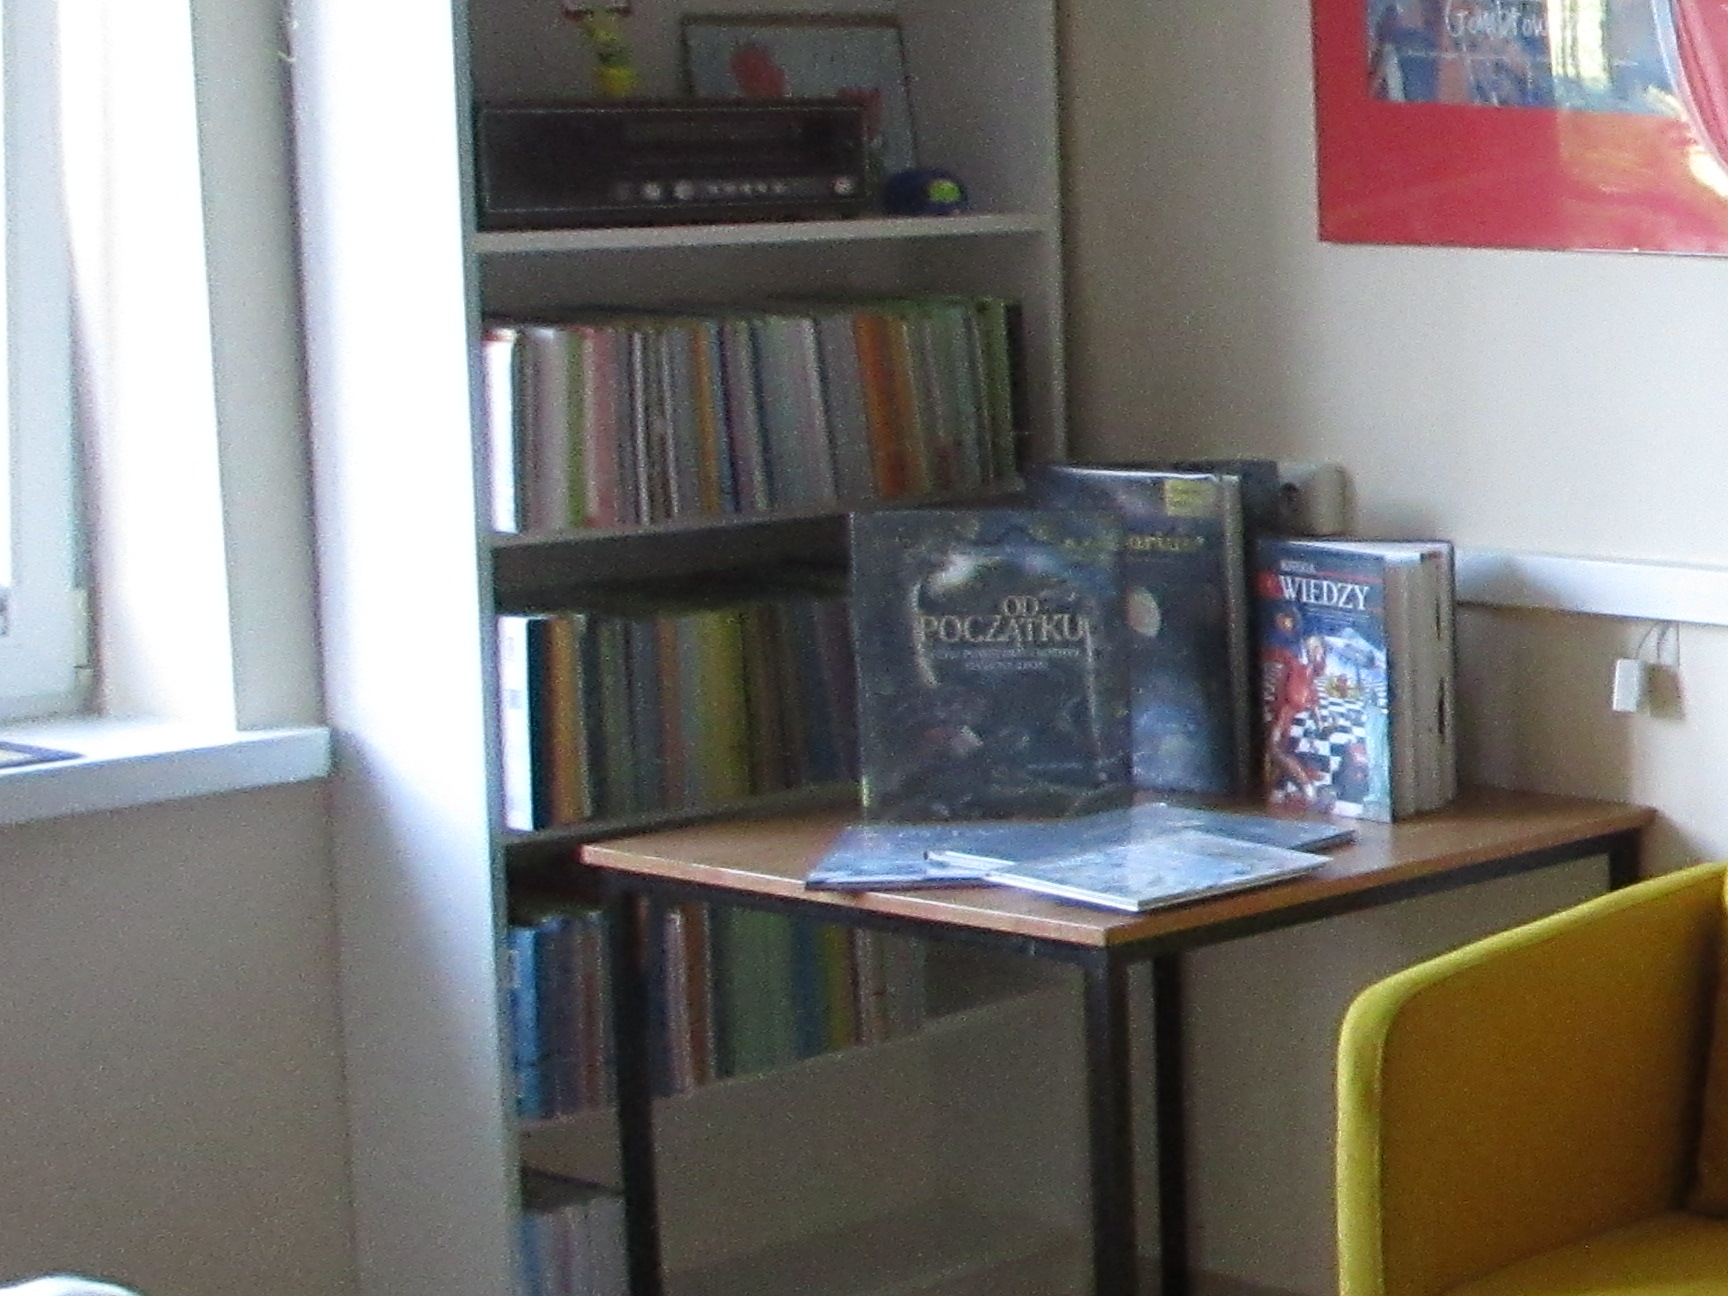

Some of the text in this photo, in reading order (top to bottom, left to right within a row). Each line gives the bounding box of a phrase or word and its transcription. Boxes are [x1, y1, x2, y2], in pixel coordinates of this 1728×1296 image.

[1003, 595, 1039, 617] OD
[1279, 574, 1371, 611] WIEDZY
[920, 613, 1084, 651] POCZĄTKU
